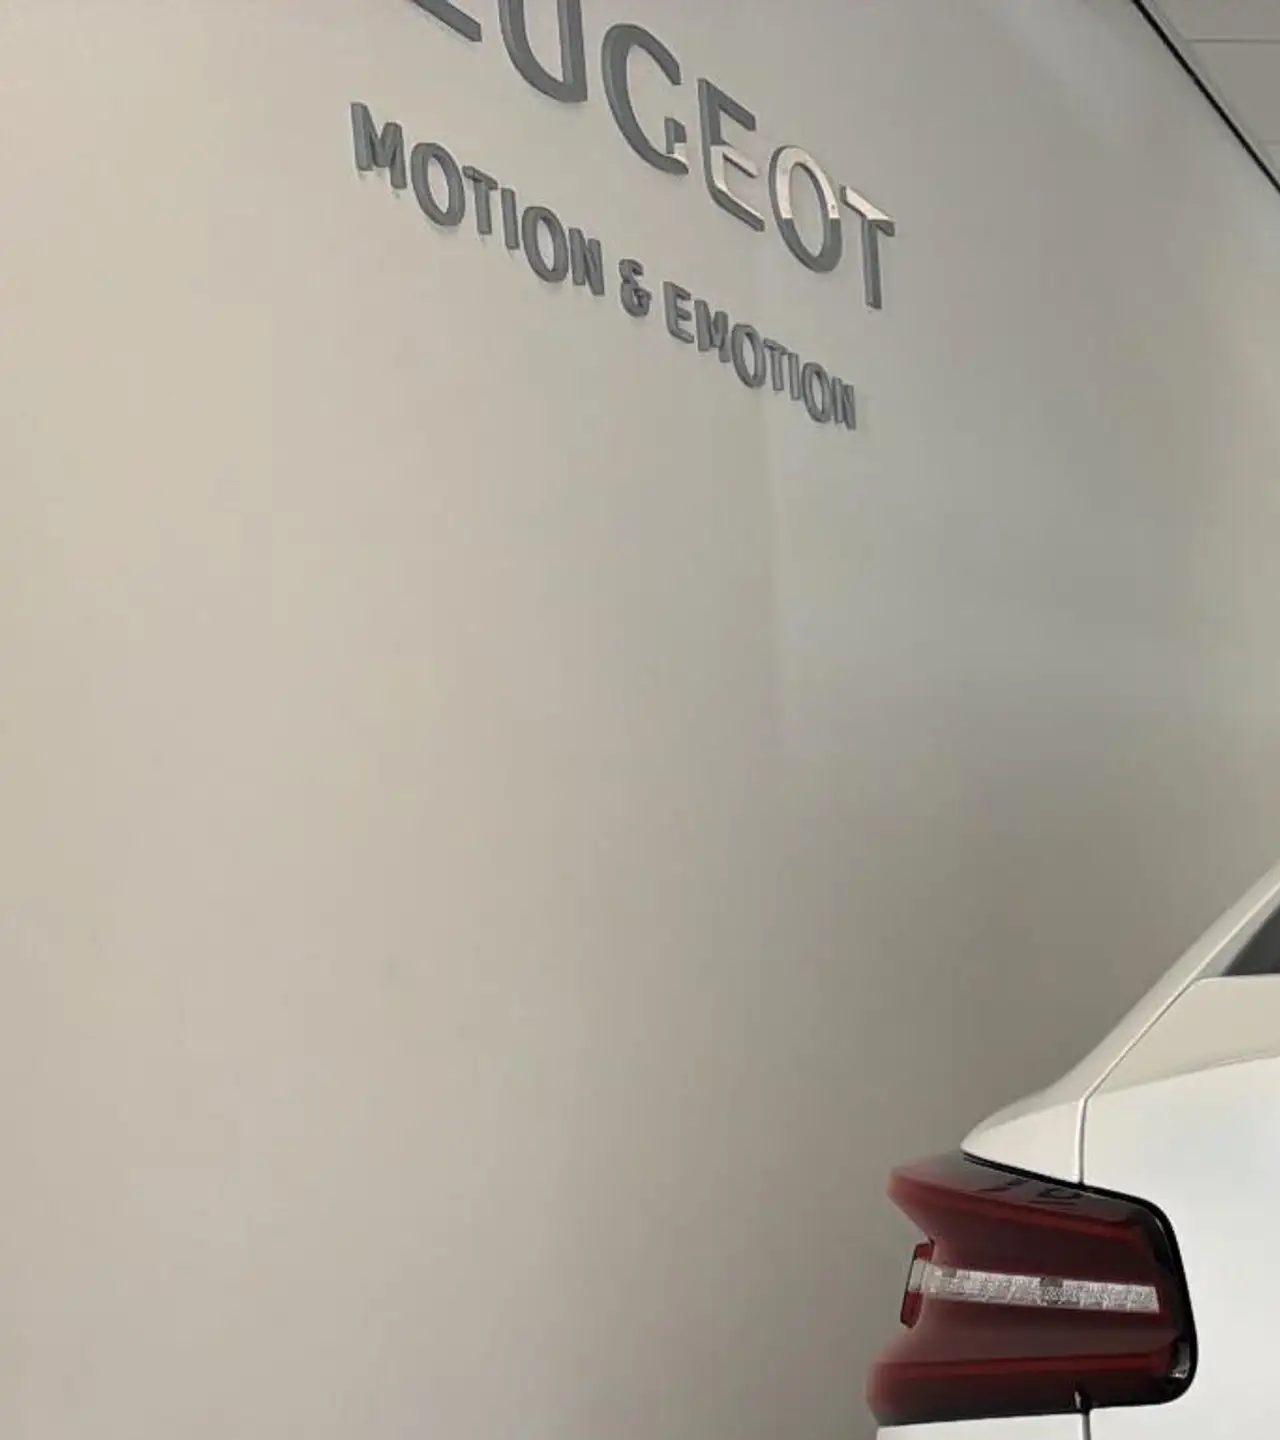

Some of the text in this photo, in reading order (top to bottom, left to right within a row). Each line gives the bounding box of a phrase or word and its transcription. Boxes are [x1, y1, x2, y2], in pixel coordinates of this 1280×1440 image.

[350, 101, 857, 430] MOTION & EMOTION
[412, 0, 896, 310] UGEOT
